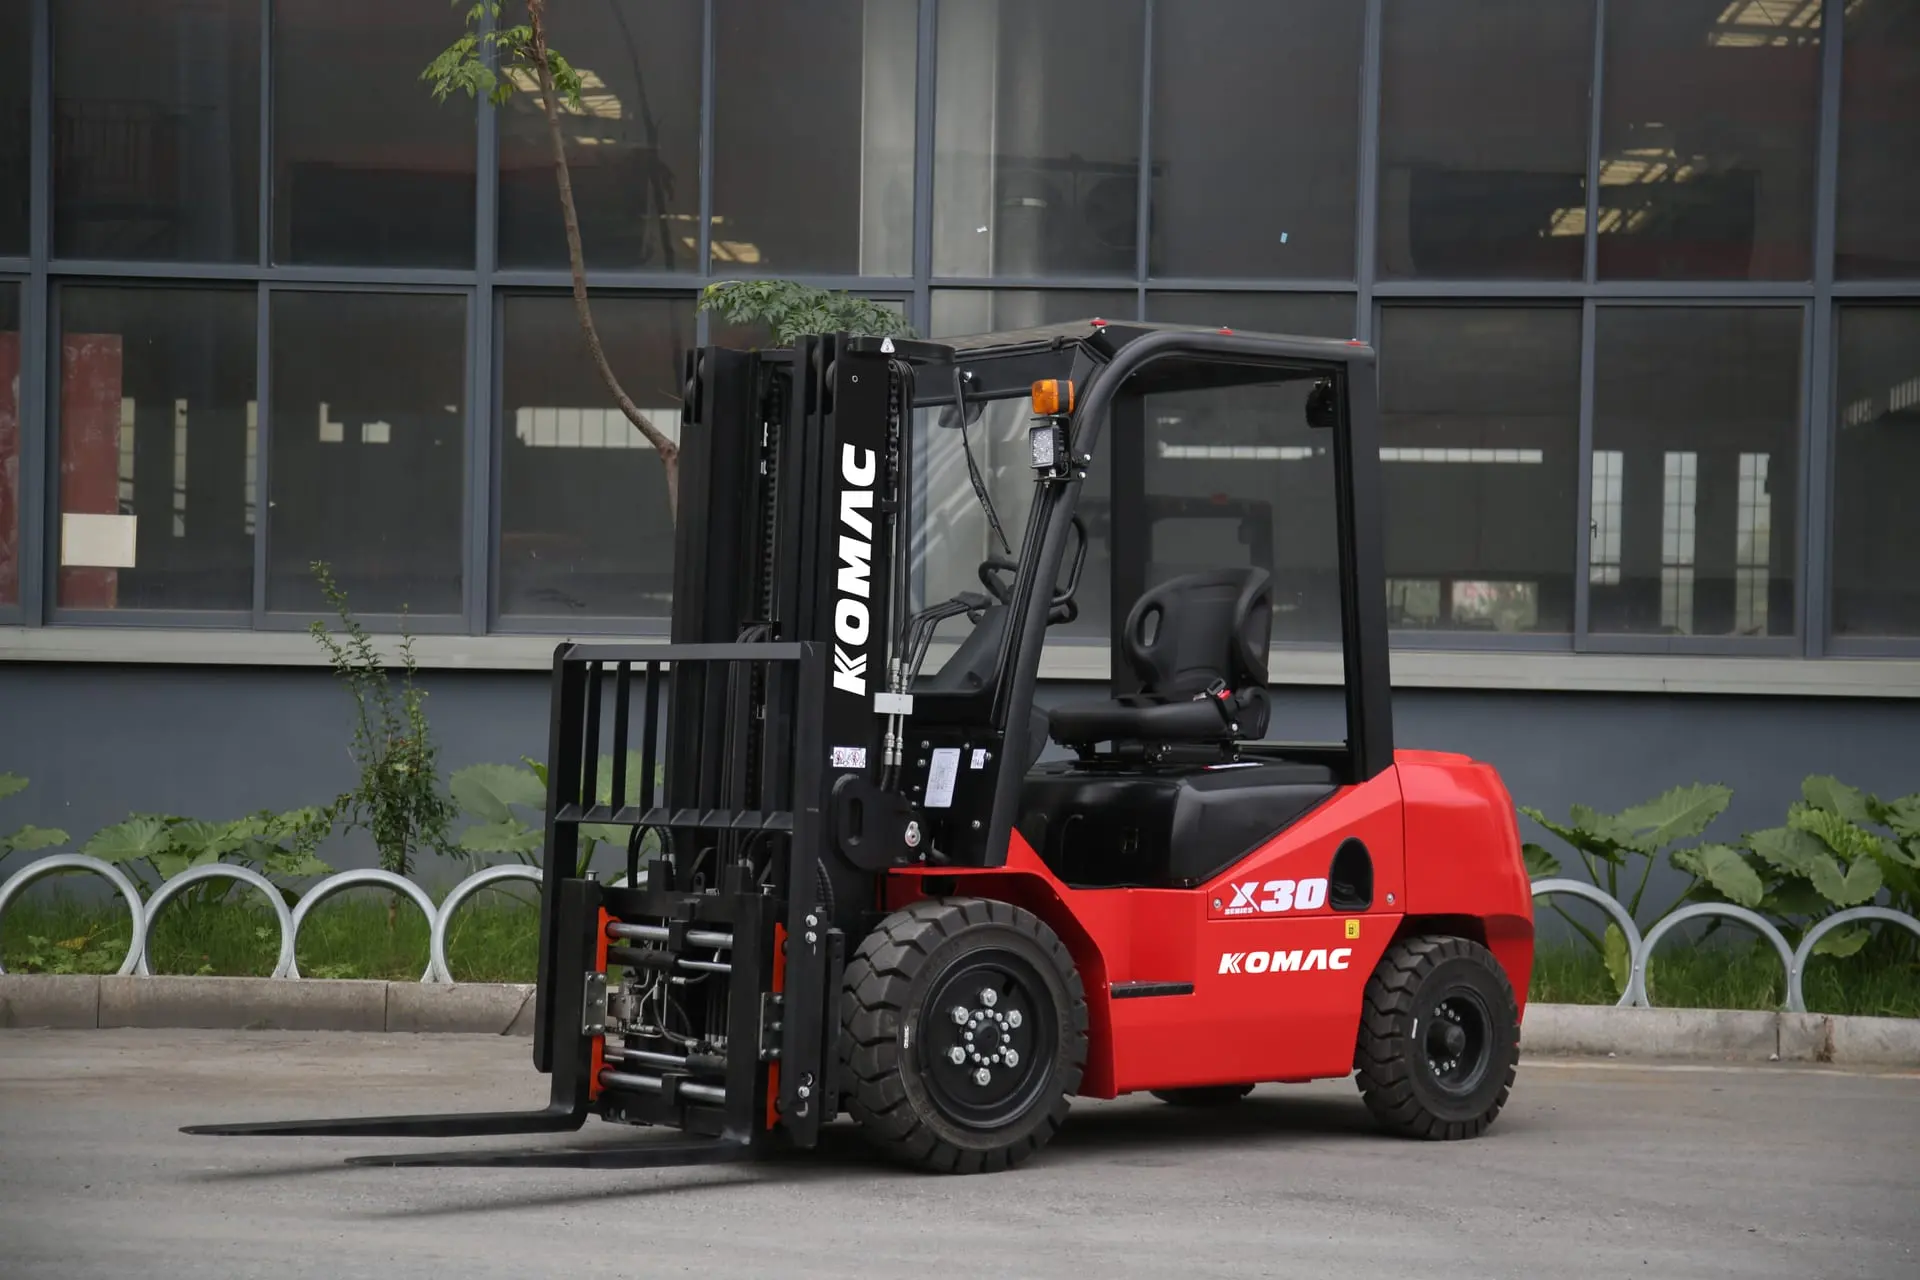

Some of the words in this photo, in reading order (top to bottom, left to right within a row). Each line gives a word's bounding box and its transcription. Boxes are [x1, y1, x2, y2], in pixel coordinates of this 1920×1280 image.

[833, 442, 877, 697] KOMAC
[1228, 877, 1328, 913] X30
[1224, 906, 1254, 916] SERIES
[1218, 948, 1352, 975] KOMAC
